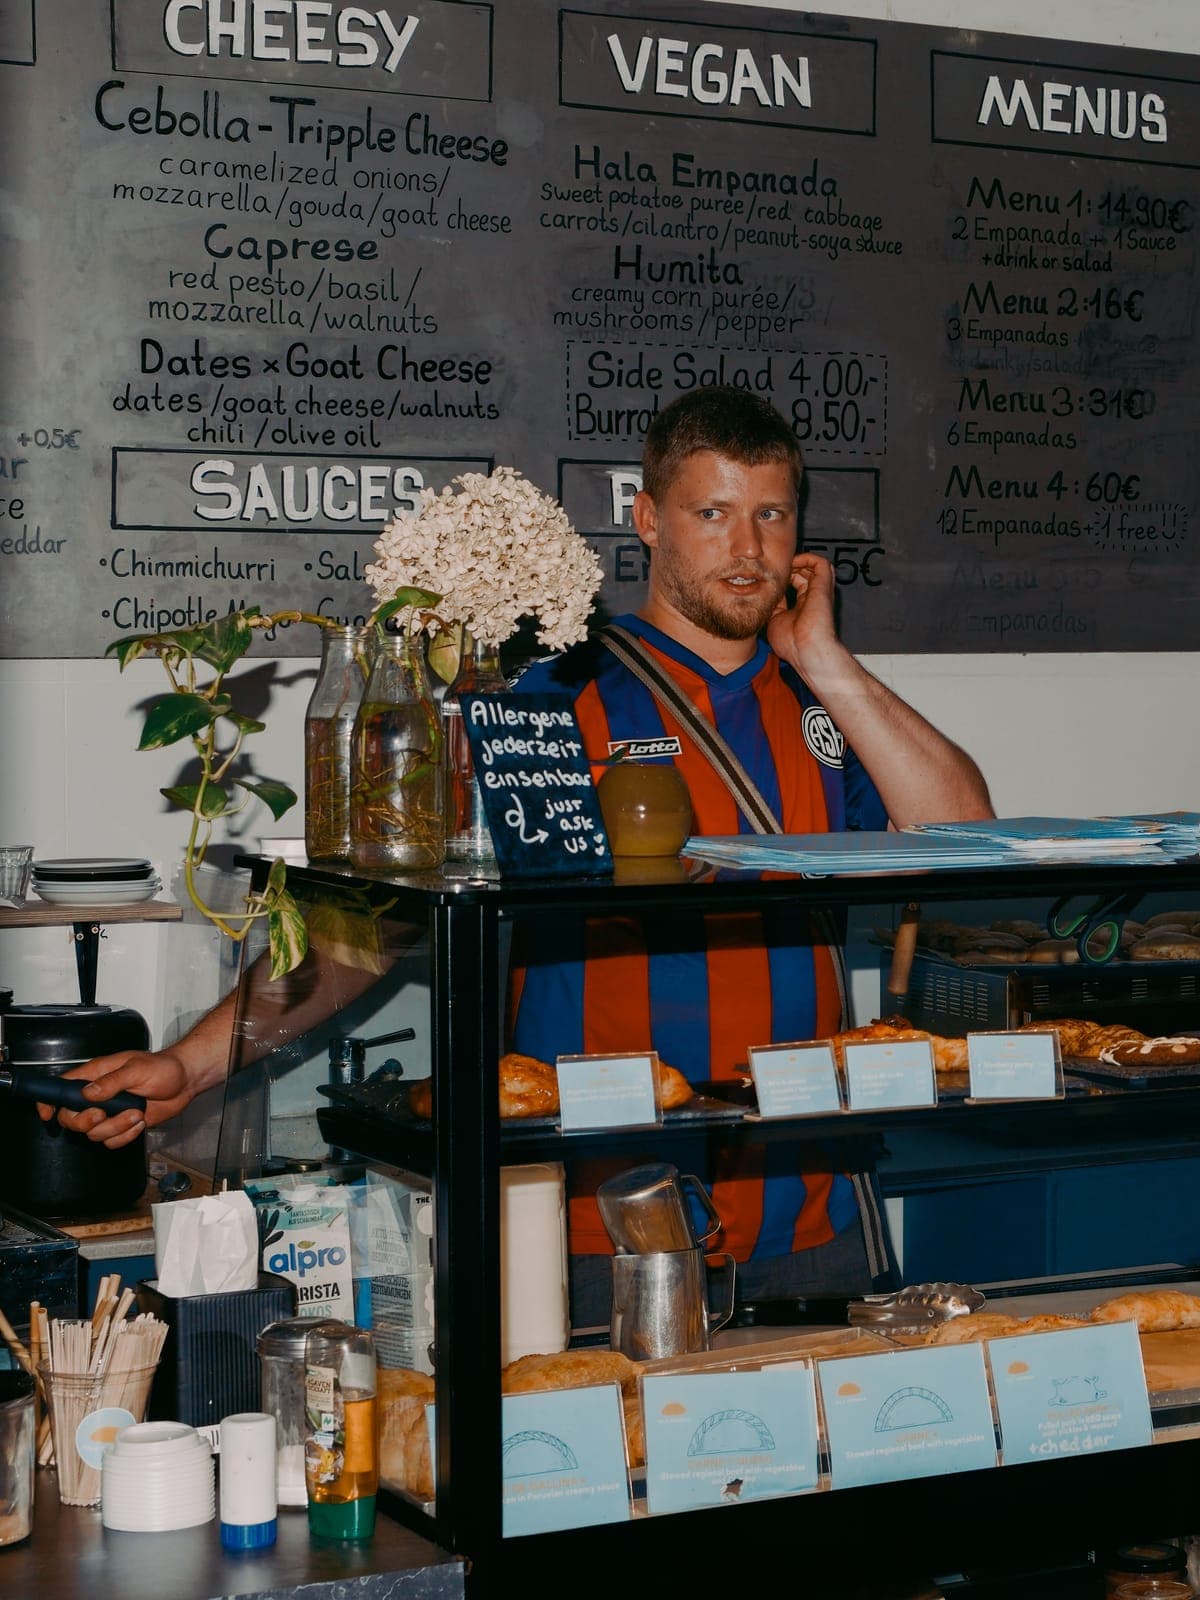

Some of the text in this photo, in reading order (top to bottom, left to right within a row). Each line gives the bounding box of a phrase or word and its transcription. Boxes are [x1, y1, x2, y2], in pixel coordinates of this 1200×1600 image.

[163, 0, 420, 73] CHEESY
[607, 33, 812, 108] VEGAN
[977, 75, 1168, 143] MENUS
[405, 112, 510, 167] Cheese
[159, 151, 339, 187] caramelized
[574, 144, 839, 199] Hala Empanada
[540, 183, 602, 204] Sweet
[609, 187, 683, 211] potatoe
[803, 198, 883, 236] cabbage
[966, 176, 1060, 214] Menu
[447, 198, 512, 234] cheese
[204, 223, 380, 274] Caprese
[952, 217, 968, 241] 2
[974, 217, 1082, 247] Empanada
[1113, 229, 1124, 250] 1
[1127, 228, 1177, 251] Sauce
[169, 262, 218, 290] red
[613, 245, 744, 285] Humita
[1042, 253, 1059, 269] or
[1062, 250, 1113, 273] salad
[571, 288, 645, 314] creamy
[651, 289, 702, 309] corn
[963, 280, 1049, 315] Menu
[947, 318, 1069, 348] 3 Empanadas
[140, 337, 252, 378] Dates
[285, 345, 365, 381] Goat
[376, 343, 493, 385] Cheese
[587, 350, 664, 391] Side
[673, 353, 775, 391] Salad
[958, 377, 1046, 413] Menu
[344, 423, 382, 450] oil
[947, 422, 1077, 454] 6 Empanadas
[193, 459, 424, 522] SAUCES
[944, 465, 1038, 499] Menu
[936, 508, 957, 535] 12
[111, 549, 276, 581] Chimmichurri
[113, 597, 217, 633] Chipotle
[470, 700, 575, 738] Allergene
[481, 735, 582, 766] jederzeit
[484, 768, 592, 789] einsehbar
[545, 799, 583, 820] just
[559, 815, 595, 831] ask
[564, 837, 588, 854] us
[269, 1243, 346, 1278] alpro
[298, 1282, 341, 1301] RISTA
